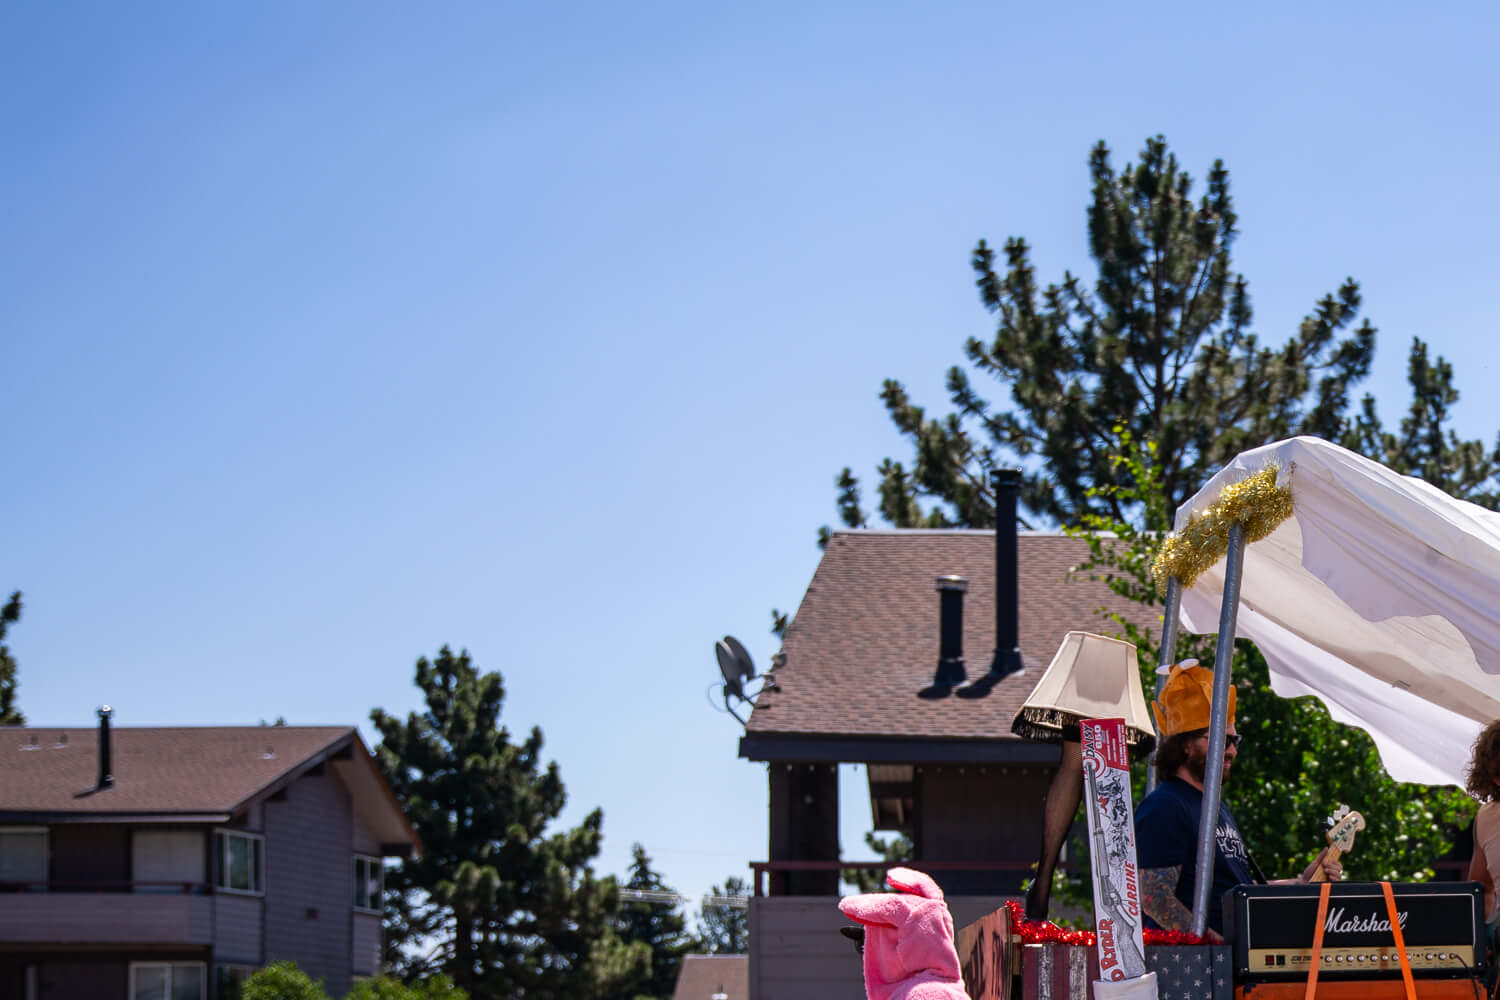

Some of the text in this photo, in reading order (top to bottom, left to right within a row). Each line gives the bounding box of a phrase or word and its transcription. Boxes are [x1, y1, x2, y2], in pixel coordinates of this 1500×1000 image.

[1083, 723, 1095, 757] DAISY
[1125, 860, 1138, 917] CARBINE
[1324, 907, 1408, 933] Marshal
[1098, 917, 1118, 971] RYDER
